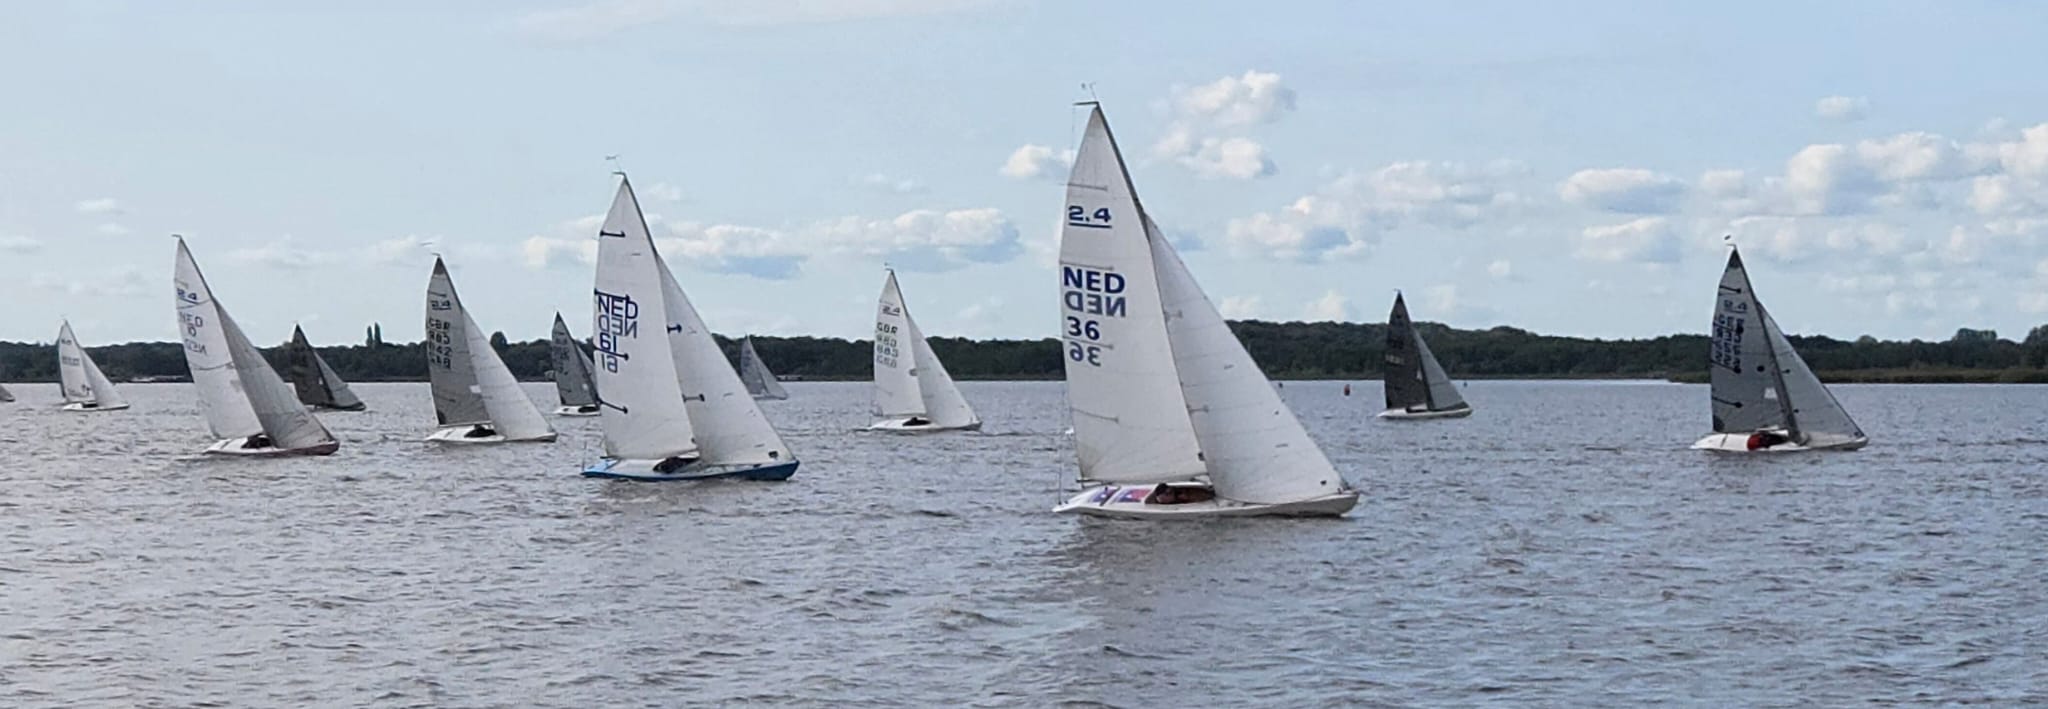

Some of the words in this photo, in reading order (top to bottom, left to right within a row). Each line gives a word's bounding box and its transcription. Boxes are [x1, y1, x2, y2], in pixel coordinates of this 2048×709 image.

[1068, 205, 1111, 223] 2.4
[1063, 266, 1125, 294] NED
[598, 294, 638, 319] NED
[1067, 316, 1100, 341] 36
[600, 332, 617, 352] 61
